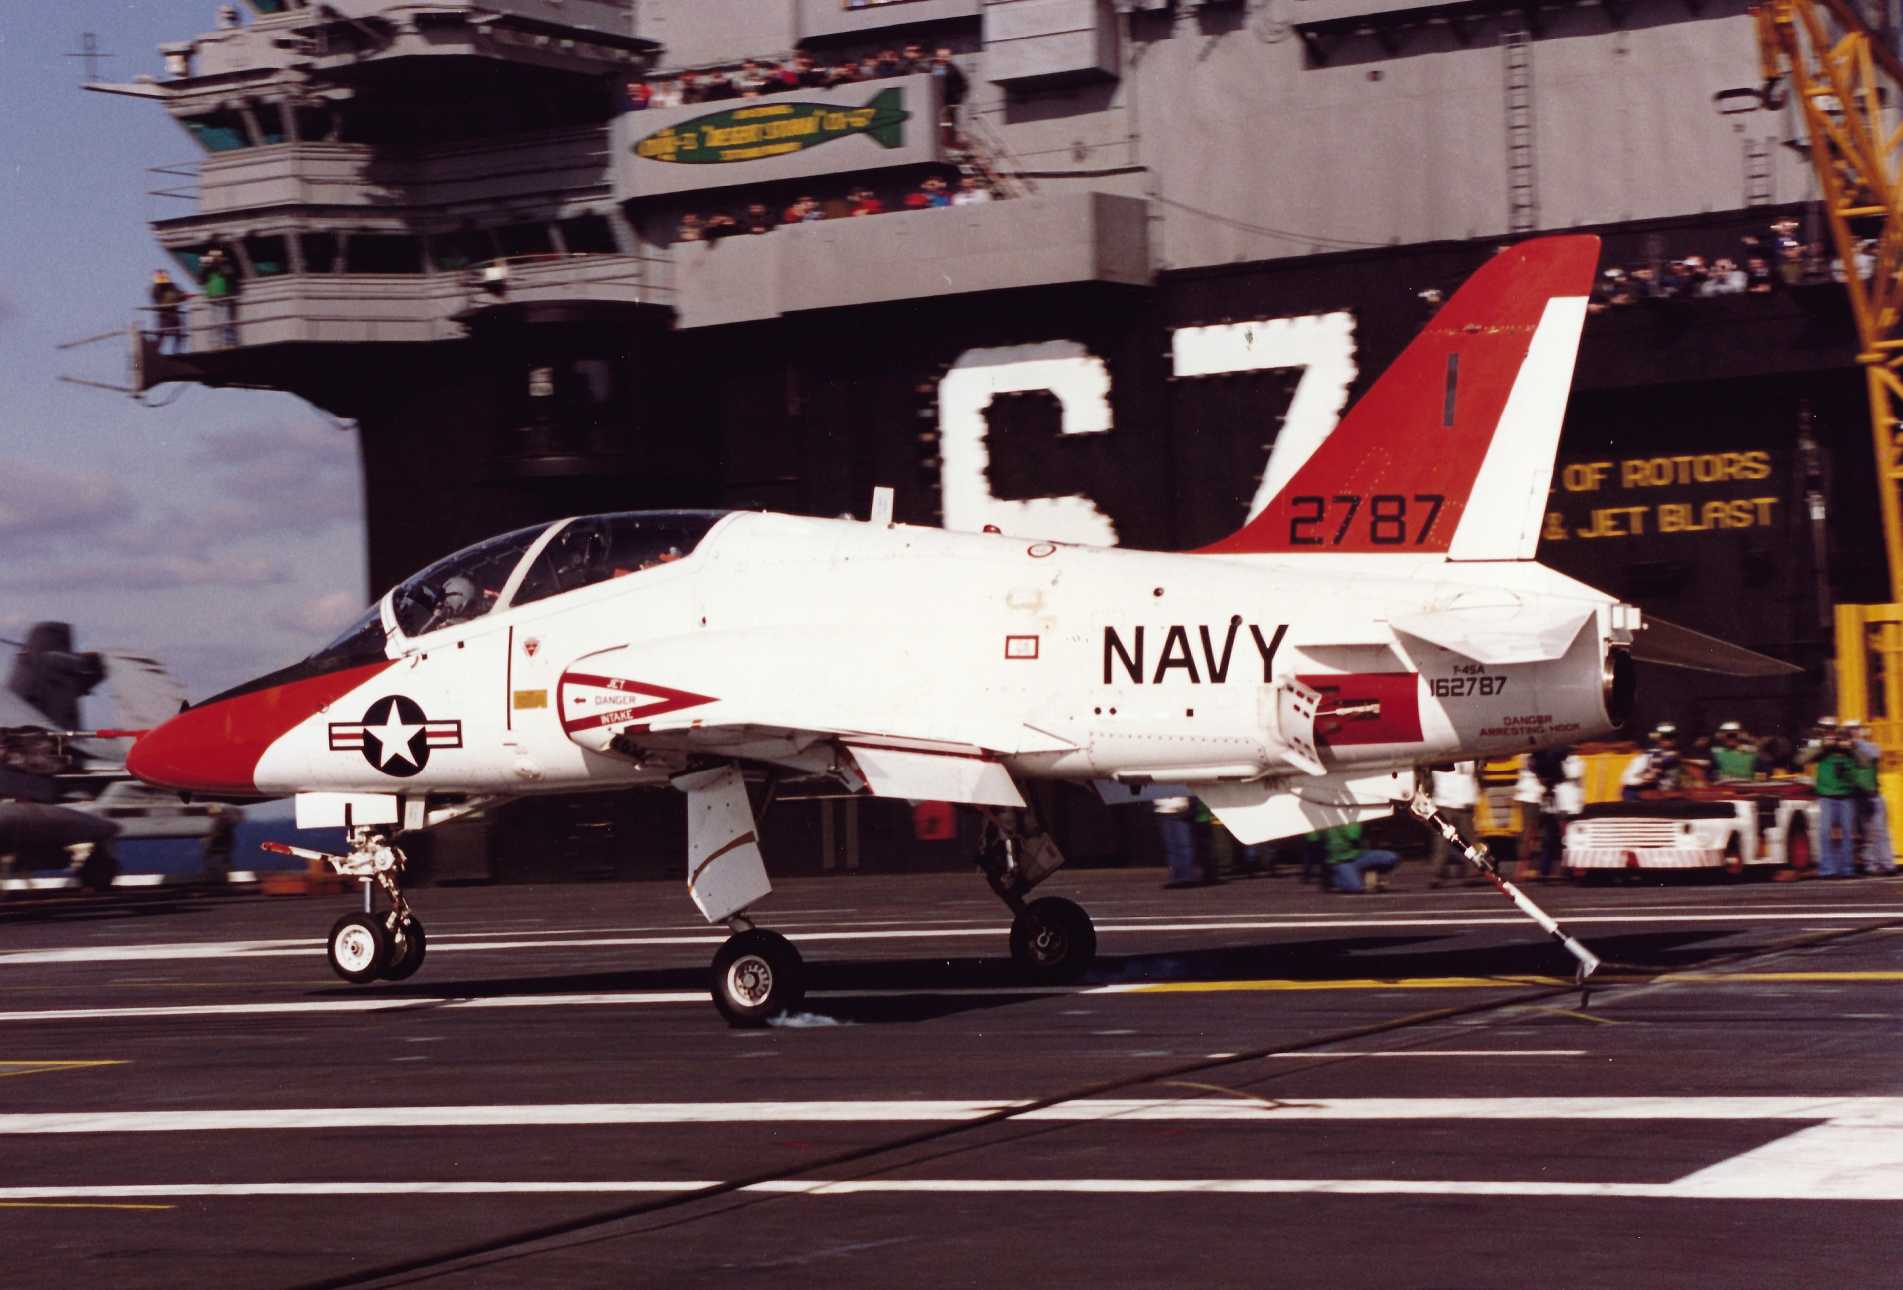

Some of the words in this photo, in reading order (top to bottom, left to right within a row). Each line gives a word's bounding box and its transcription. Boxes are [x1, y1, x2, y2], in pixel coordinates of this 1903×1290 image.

[938, 311, 1358, 547] 67
[1562, 462, 1613, 491] OF
[1621, 451, 1772, 488] ROTORS
[1289, 494, 1445, 545] 2787
[1577, 506, 1650, 538] JET
[1658, 497, 1780, 533] BLAST
[1103, 624, 1290, 685] NAVY
[606, 678, 627, 690] JET
[1430, 675, 1508, 698] 162787
[594, 695, 637, 706] DANGER
[600, 709, 634, 725] INTAKE
[1503, 714, 1553, 726] DANGER
[1479, 725, 1545, 738] ARRESTING
[1549, 722, 1581, 734] HOOK
